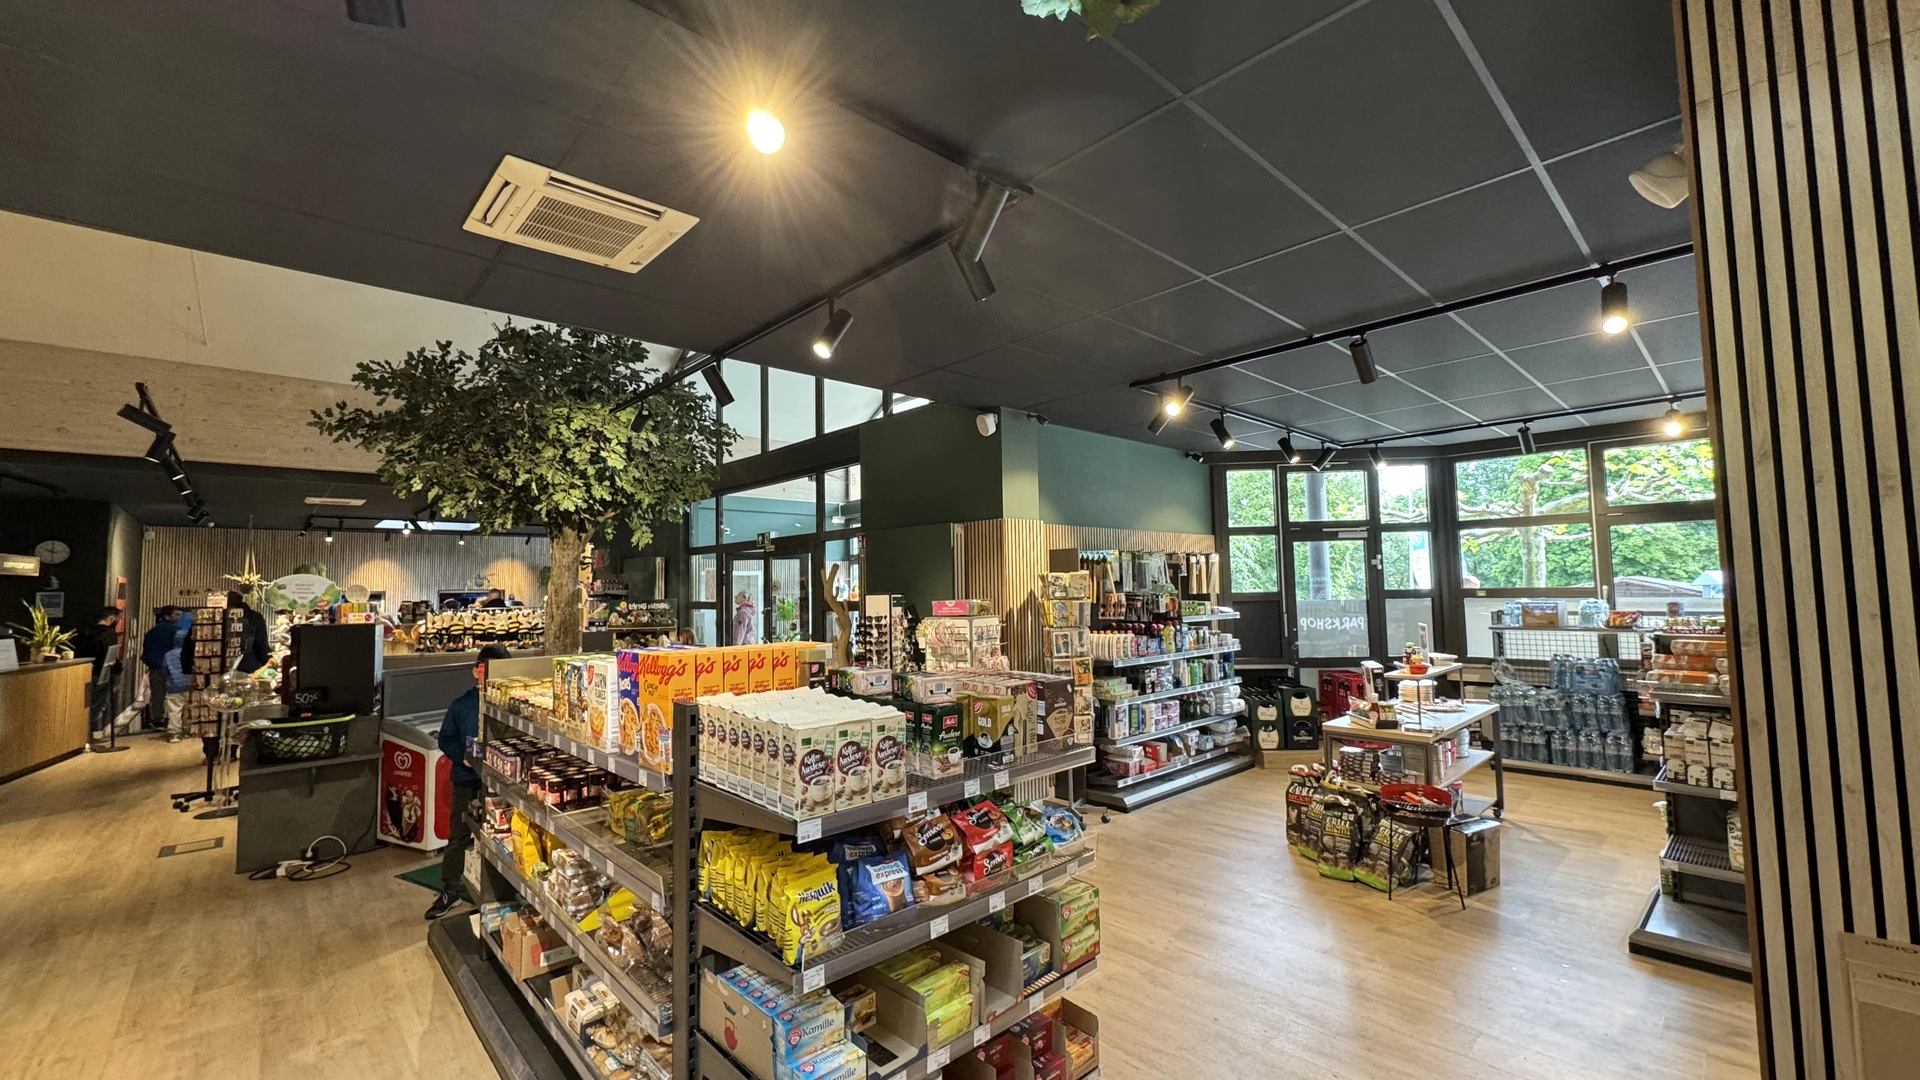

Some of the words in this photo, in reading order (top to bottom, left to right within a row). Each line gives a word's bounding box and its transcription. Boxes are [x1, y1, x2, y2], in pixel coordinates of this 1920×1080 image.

[640, 654, 688, 686] Kellogg's
[595, 672, 607, 689] CORN
[978, 716, 992, 728] GOLD
[801, 759, 826, 775] Auslese
[916, 822, 943, 846] Senseo
[875, 867, 903, 878] express
[798, 882, 836, 904] Nesquik
[792, 1000, 823, 1015] Kamille
[801, 1017, 835, 1038] Kamille
[812, 1049, 844, 1066] Kamille
